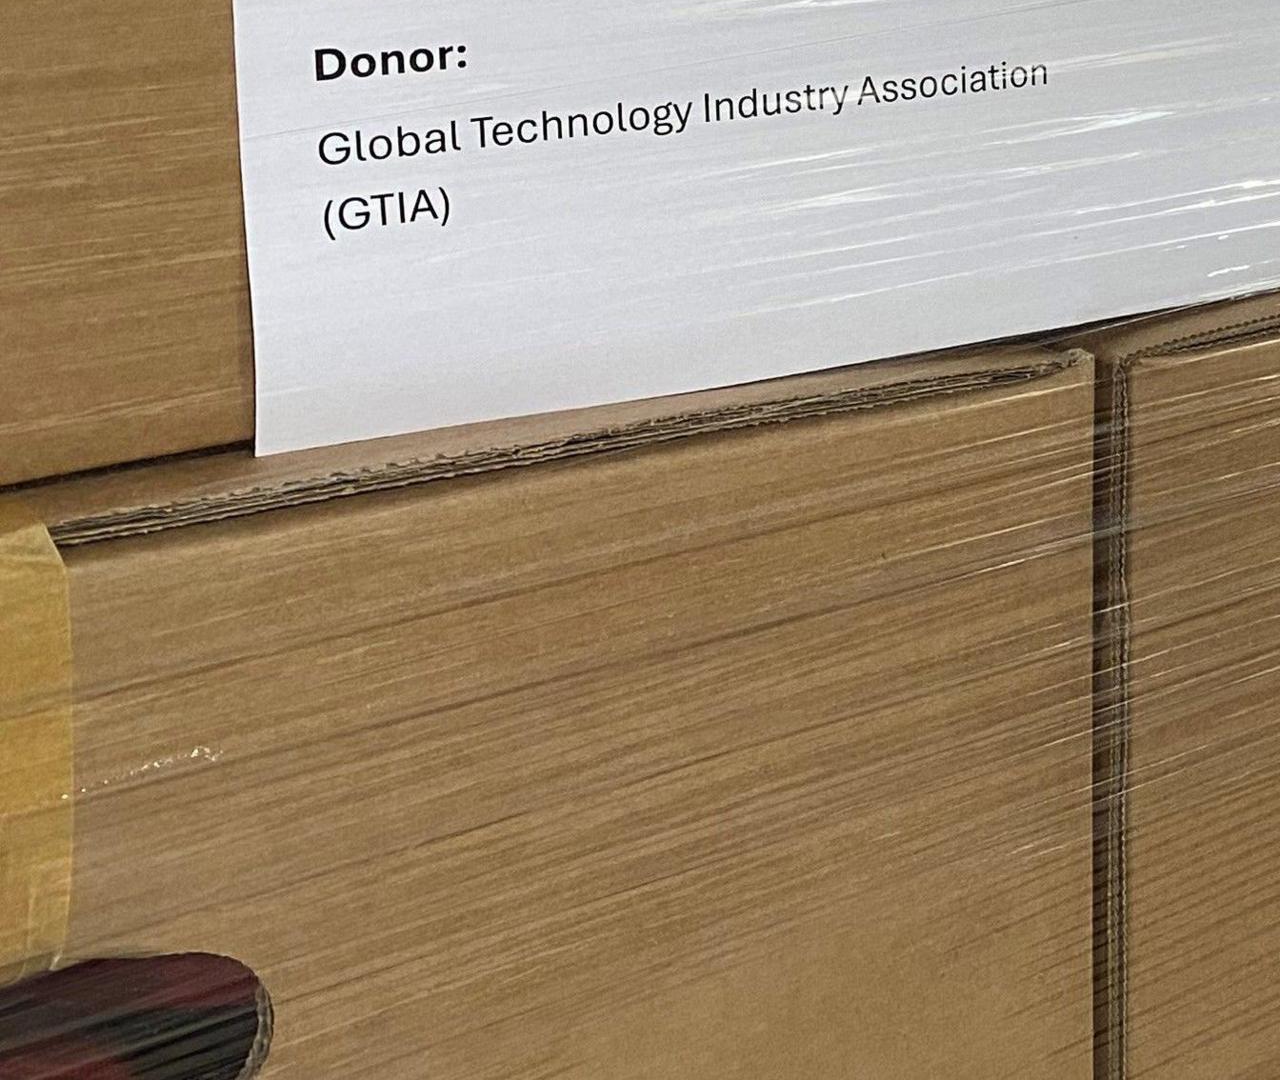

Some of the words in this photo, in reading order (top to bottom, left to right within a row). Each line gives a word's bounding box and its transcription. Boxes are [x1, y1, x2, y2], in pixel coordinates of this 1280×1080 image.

[313, 40, 469, 82] Donor:
[319, 121, 461, 166] Global
[472, 94, 693, 150] Technology
[704, 78, 849, 124] Industry
[858, 61, 1049, 107] Association
[322, 186, 452, 241] (GTIA)
